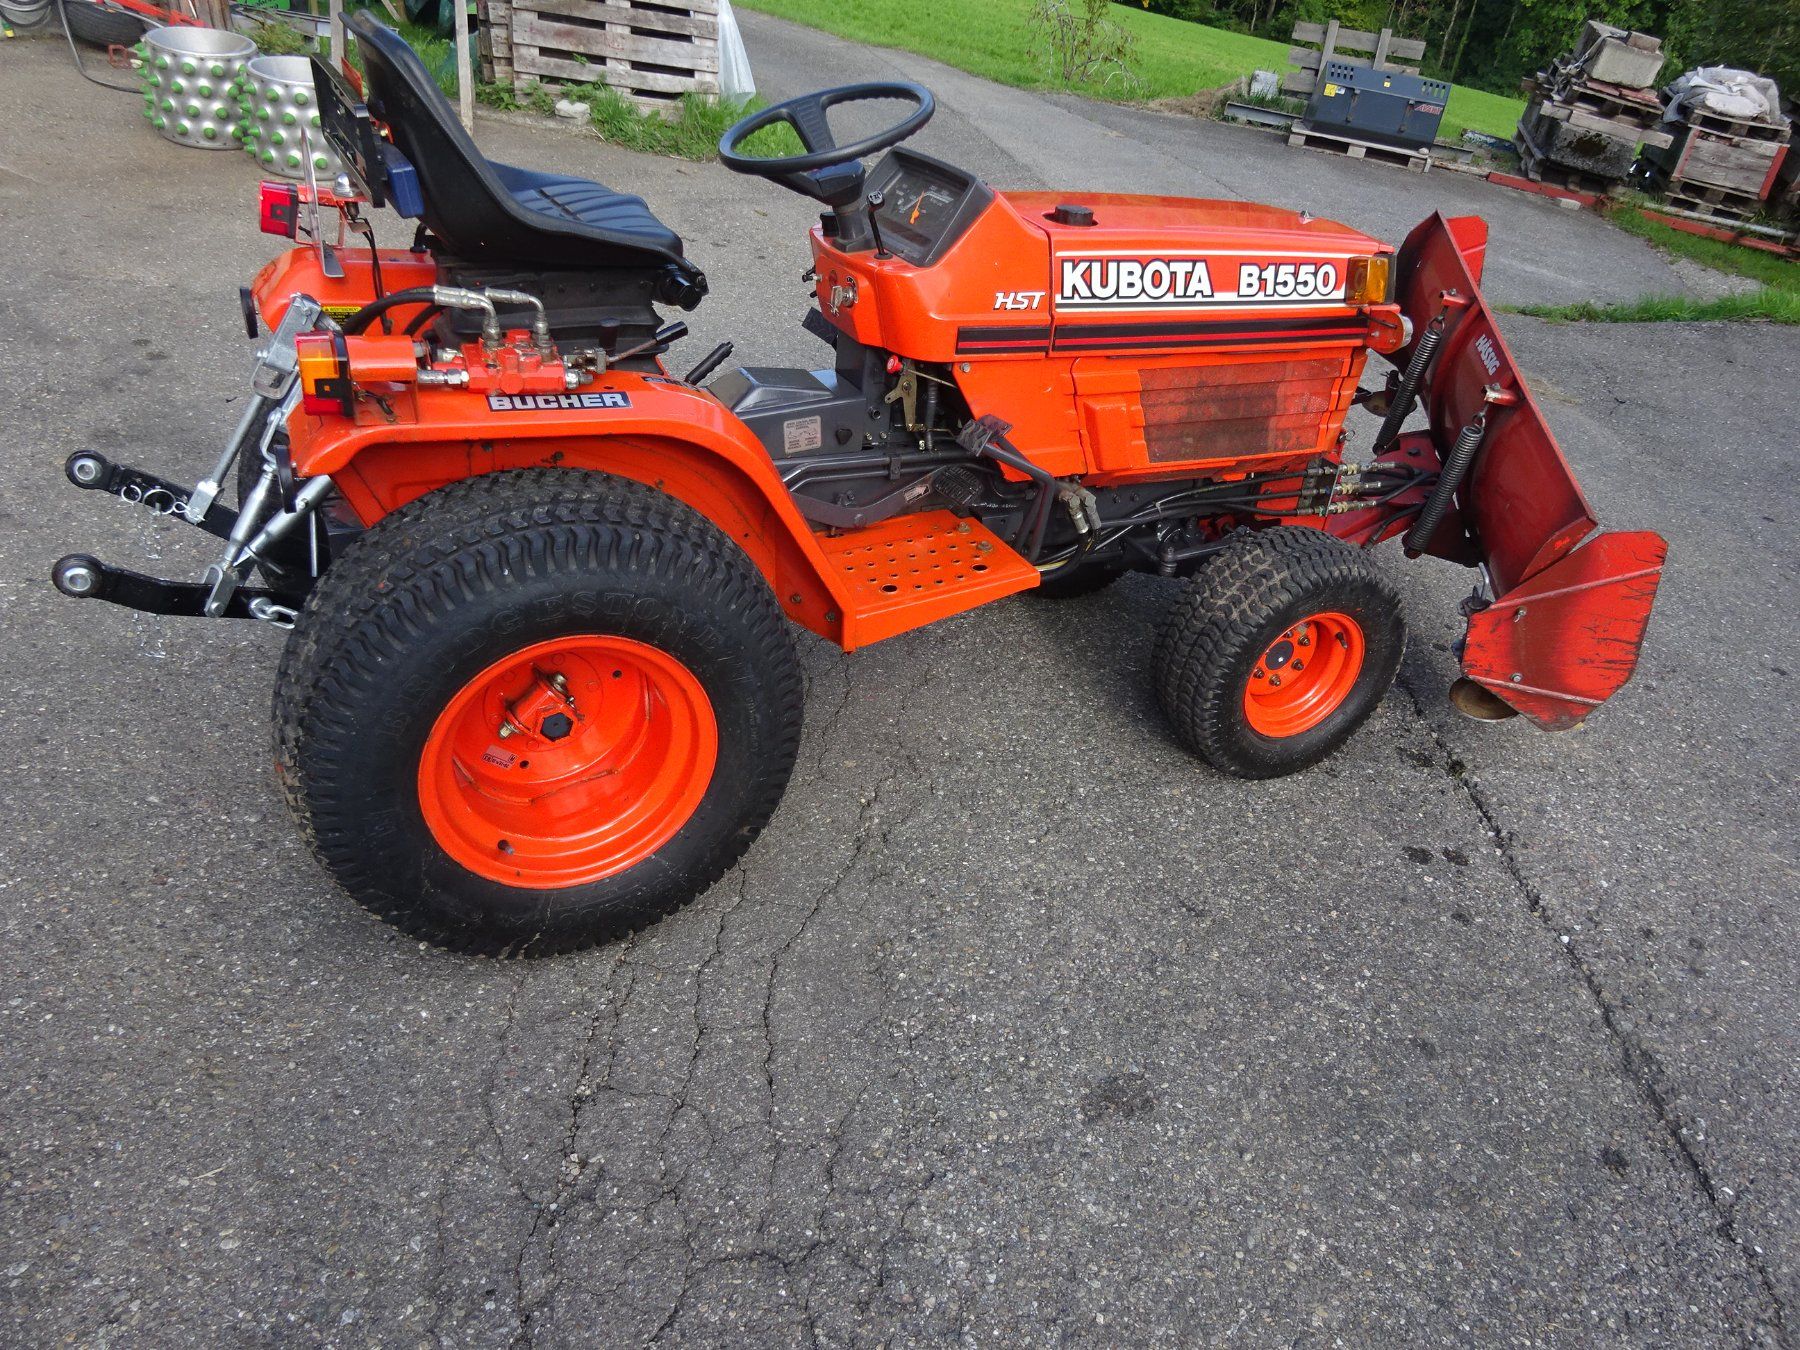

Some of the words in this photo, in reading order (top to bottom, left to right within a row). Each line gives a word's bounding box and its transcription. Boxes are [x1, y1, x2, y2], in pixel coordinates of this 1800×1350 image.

[1061, 258, 1214, 300] KUBOTA
[1237, 261, 1338, 297] B1550
[992, 292, 1046, 310] HST
[490, 392, 627, 410] BUCHER
